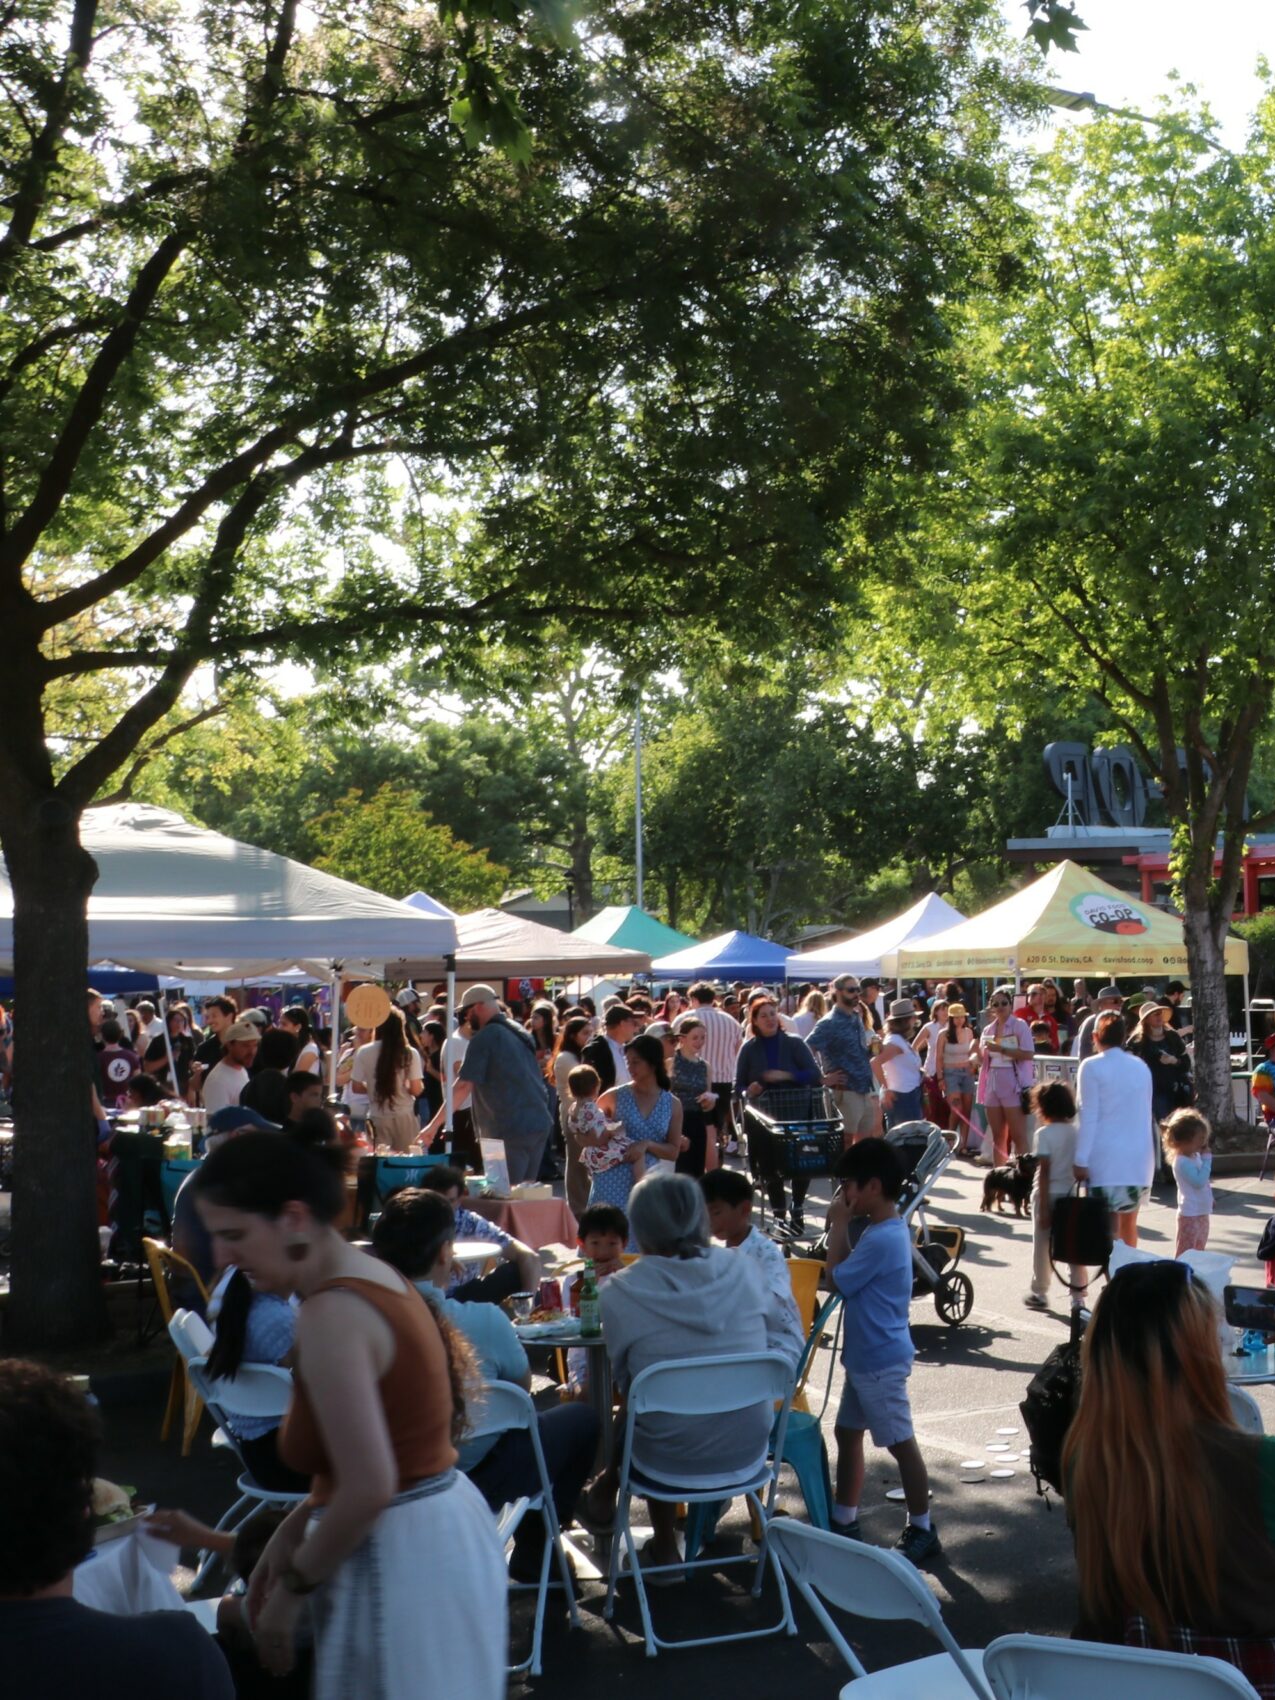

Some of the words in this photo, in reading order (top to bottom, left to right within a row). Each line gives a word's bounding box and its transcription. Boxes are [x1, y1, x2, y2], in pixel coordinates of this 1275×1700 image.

[1088, 908, 1133, 924] CO-OP
[1049, 955, 1059, 964] St.
[1060, 955, 1082, 965] Davis,
[1082, 955, 1094, 964] CA
